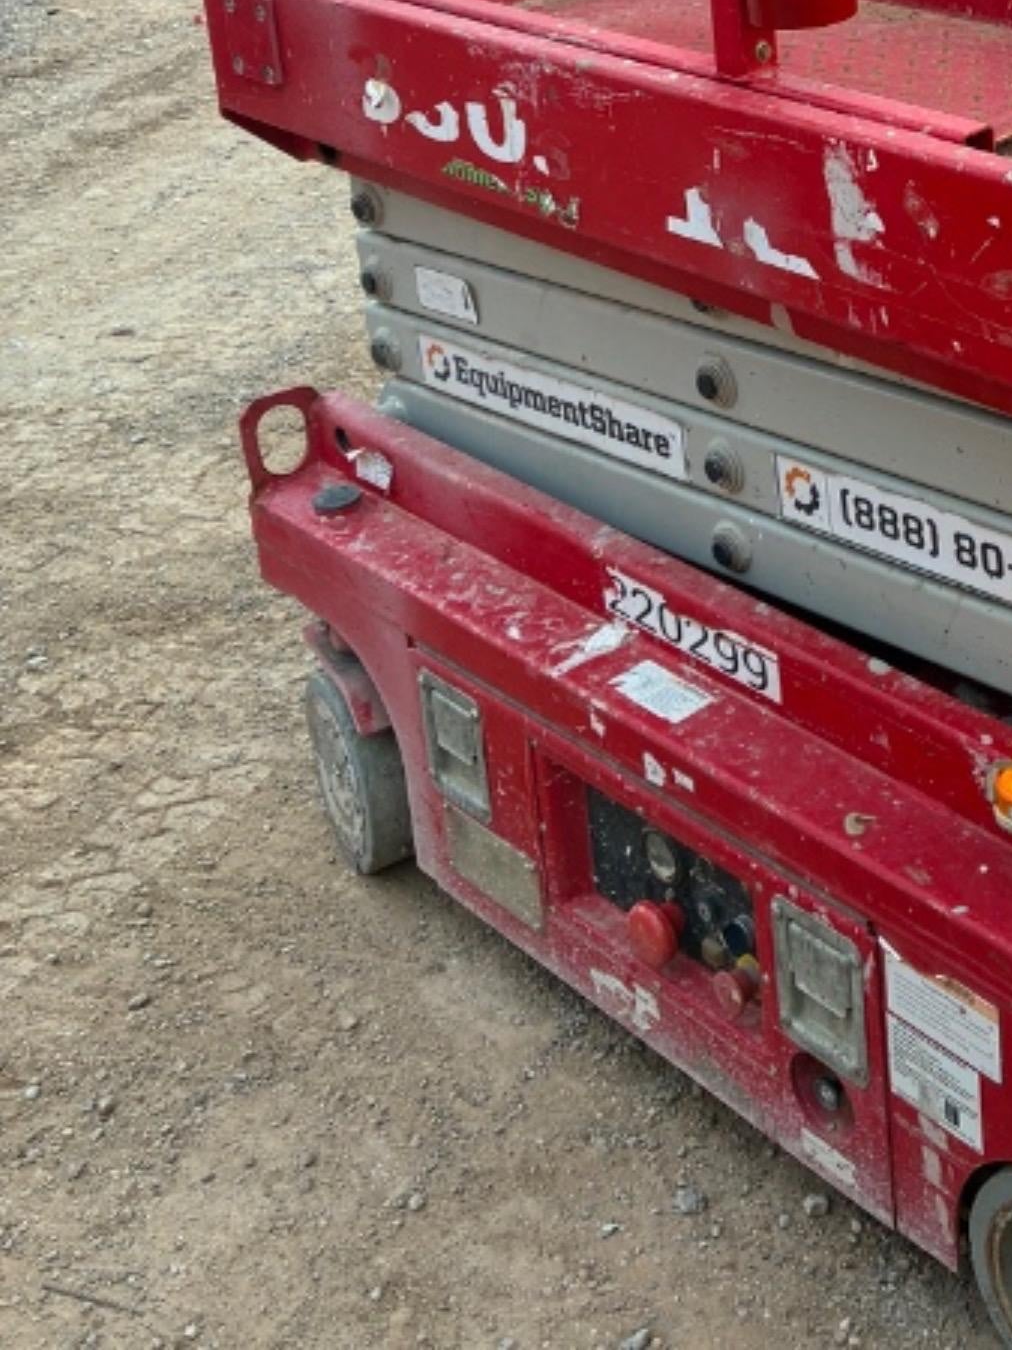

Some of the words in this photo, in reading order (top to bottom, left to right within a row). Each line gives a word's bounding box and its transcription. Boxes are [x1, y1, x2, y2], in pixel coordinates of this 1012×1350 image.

[452, 354, 673, 459] EquipmentShare
[840, 487, 940, 558] (888)
[609, 575, 769, 691] 220299
